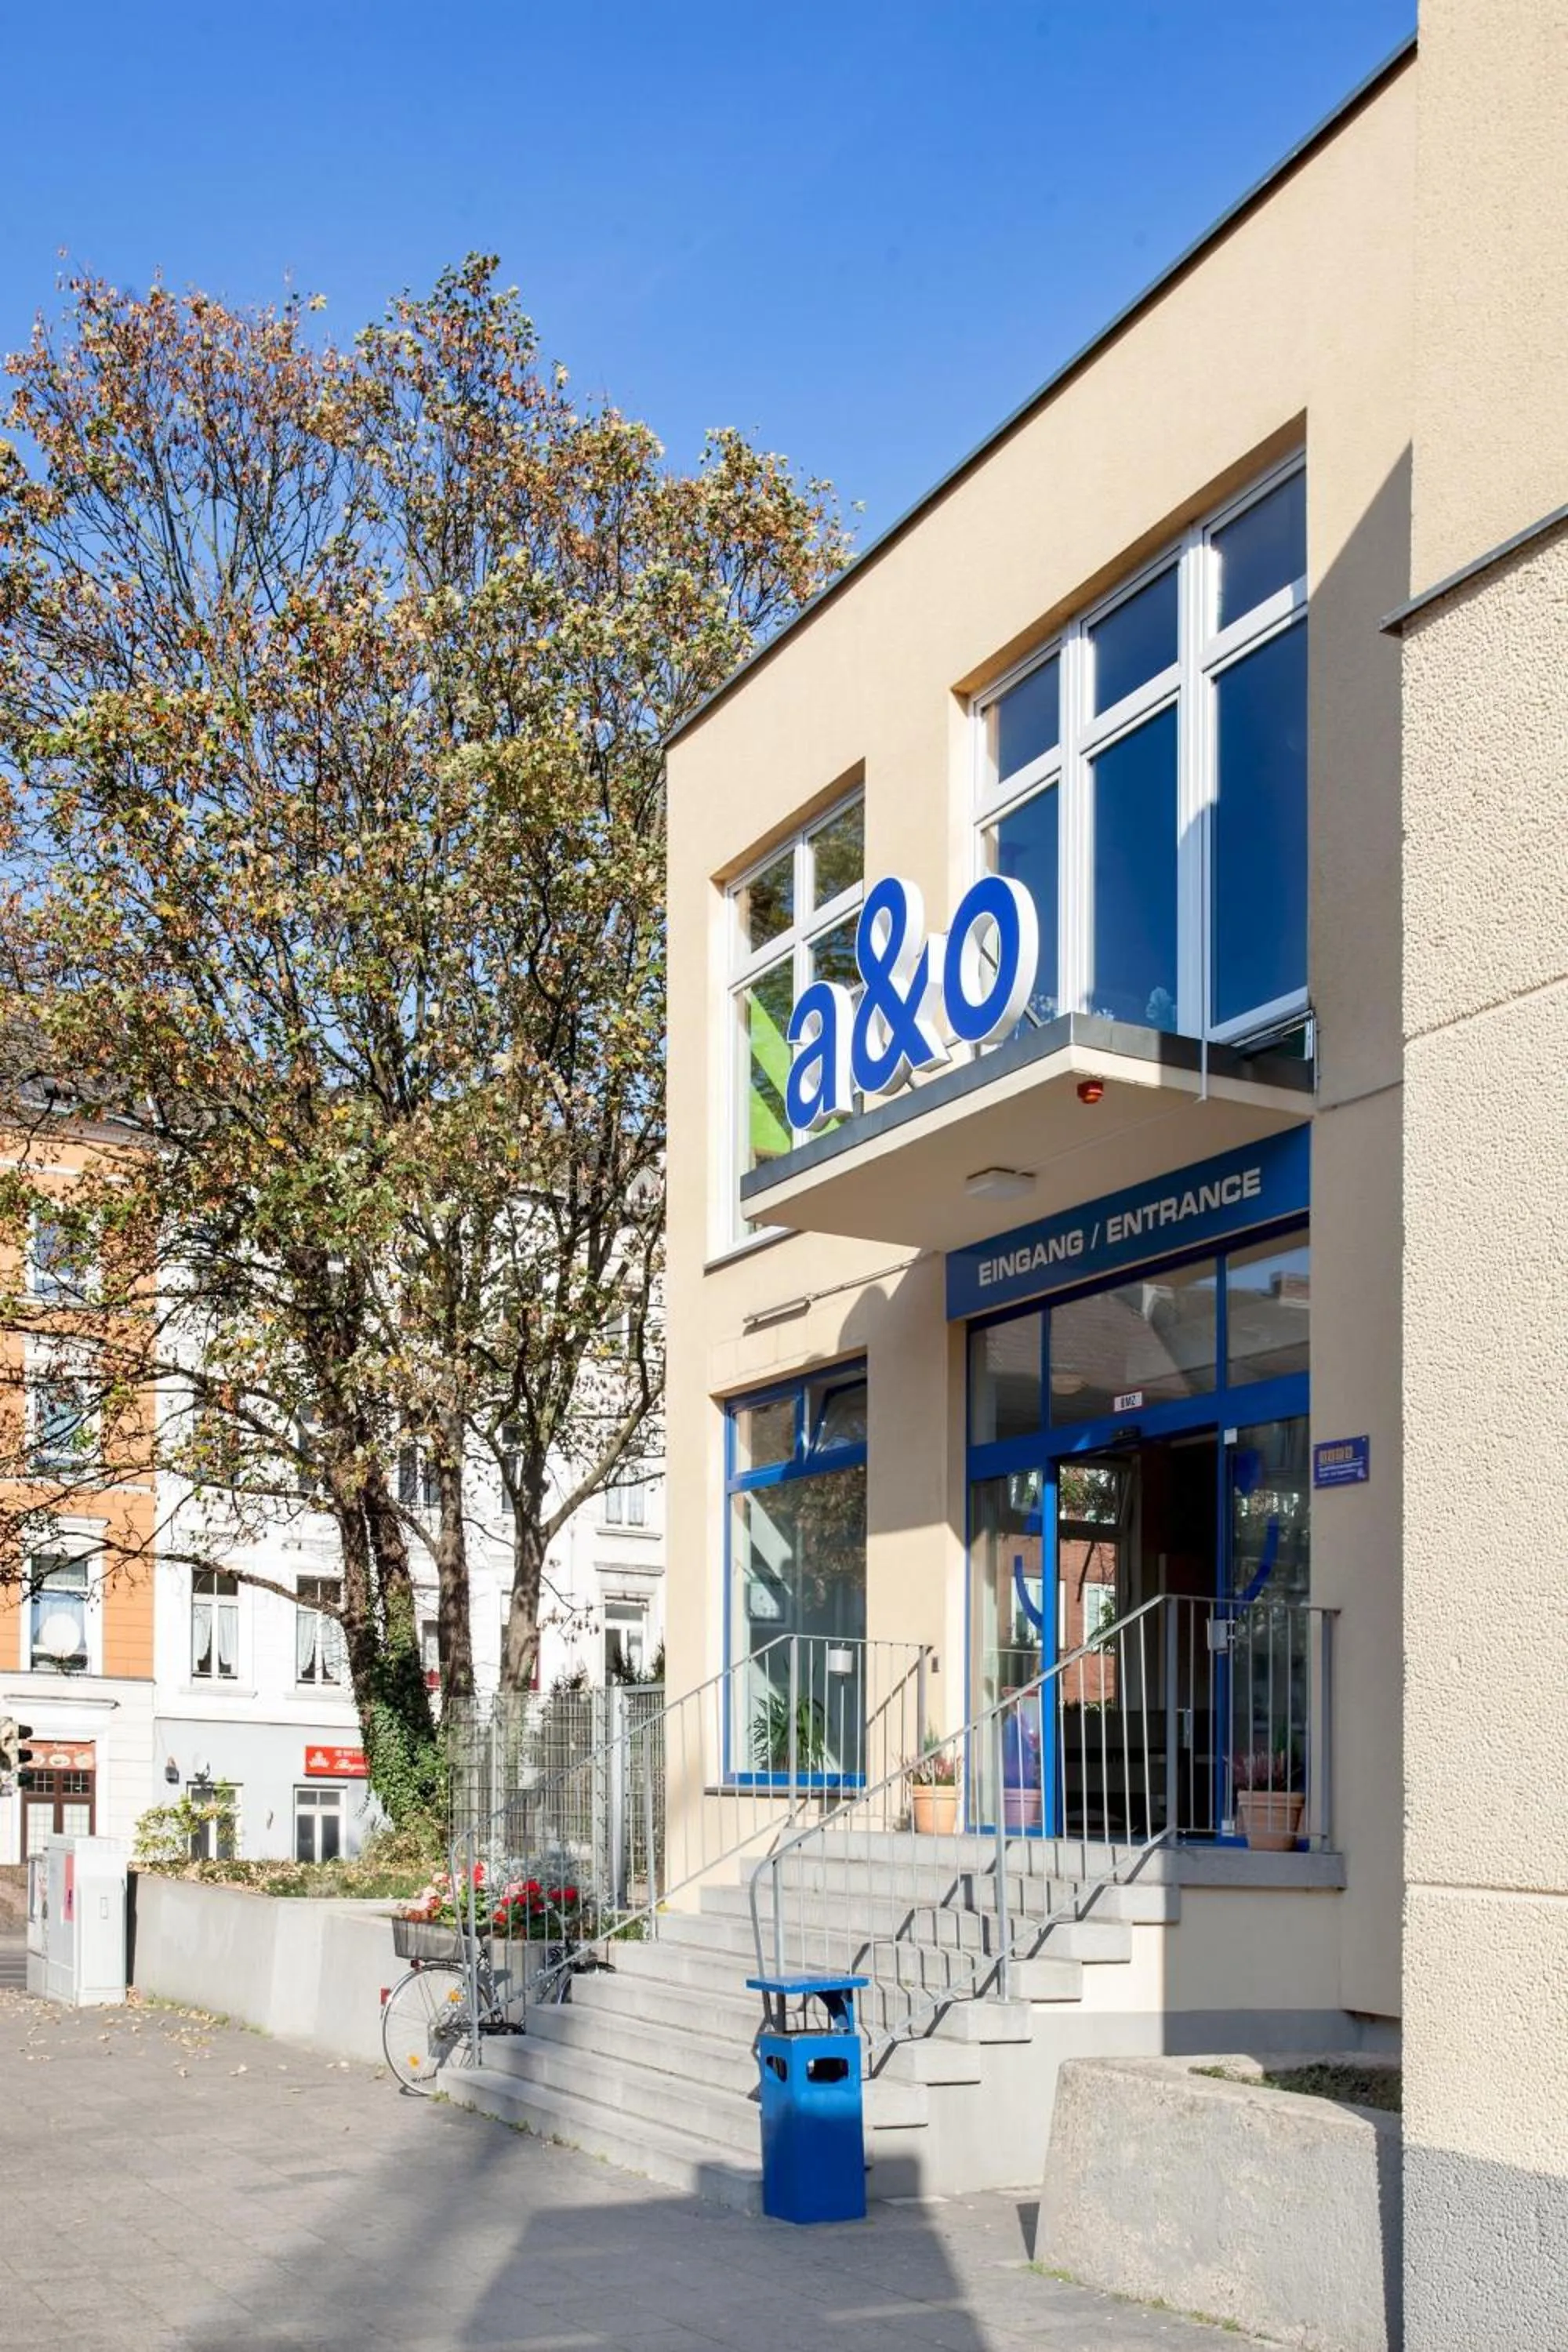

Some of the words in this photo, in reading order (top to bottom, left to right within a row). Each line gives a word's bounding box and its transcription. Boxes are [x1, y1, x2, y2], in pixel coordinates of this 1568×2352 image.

[786, 876, 1039, 1131] a&o
[978, 1230, 1084, 1287] EINGANG
[1106, 1167, 1261, 1244] ENTRANCE
